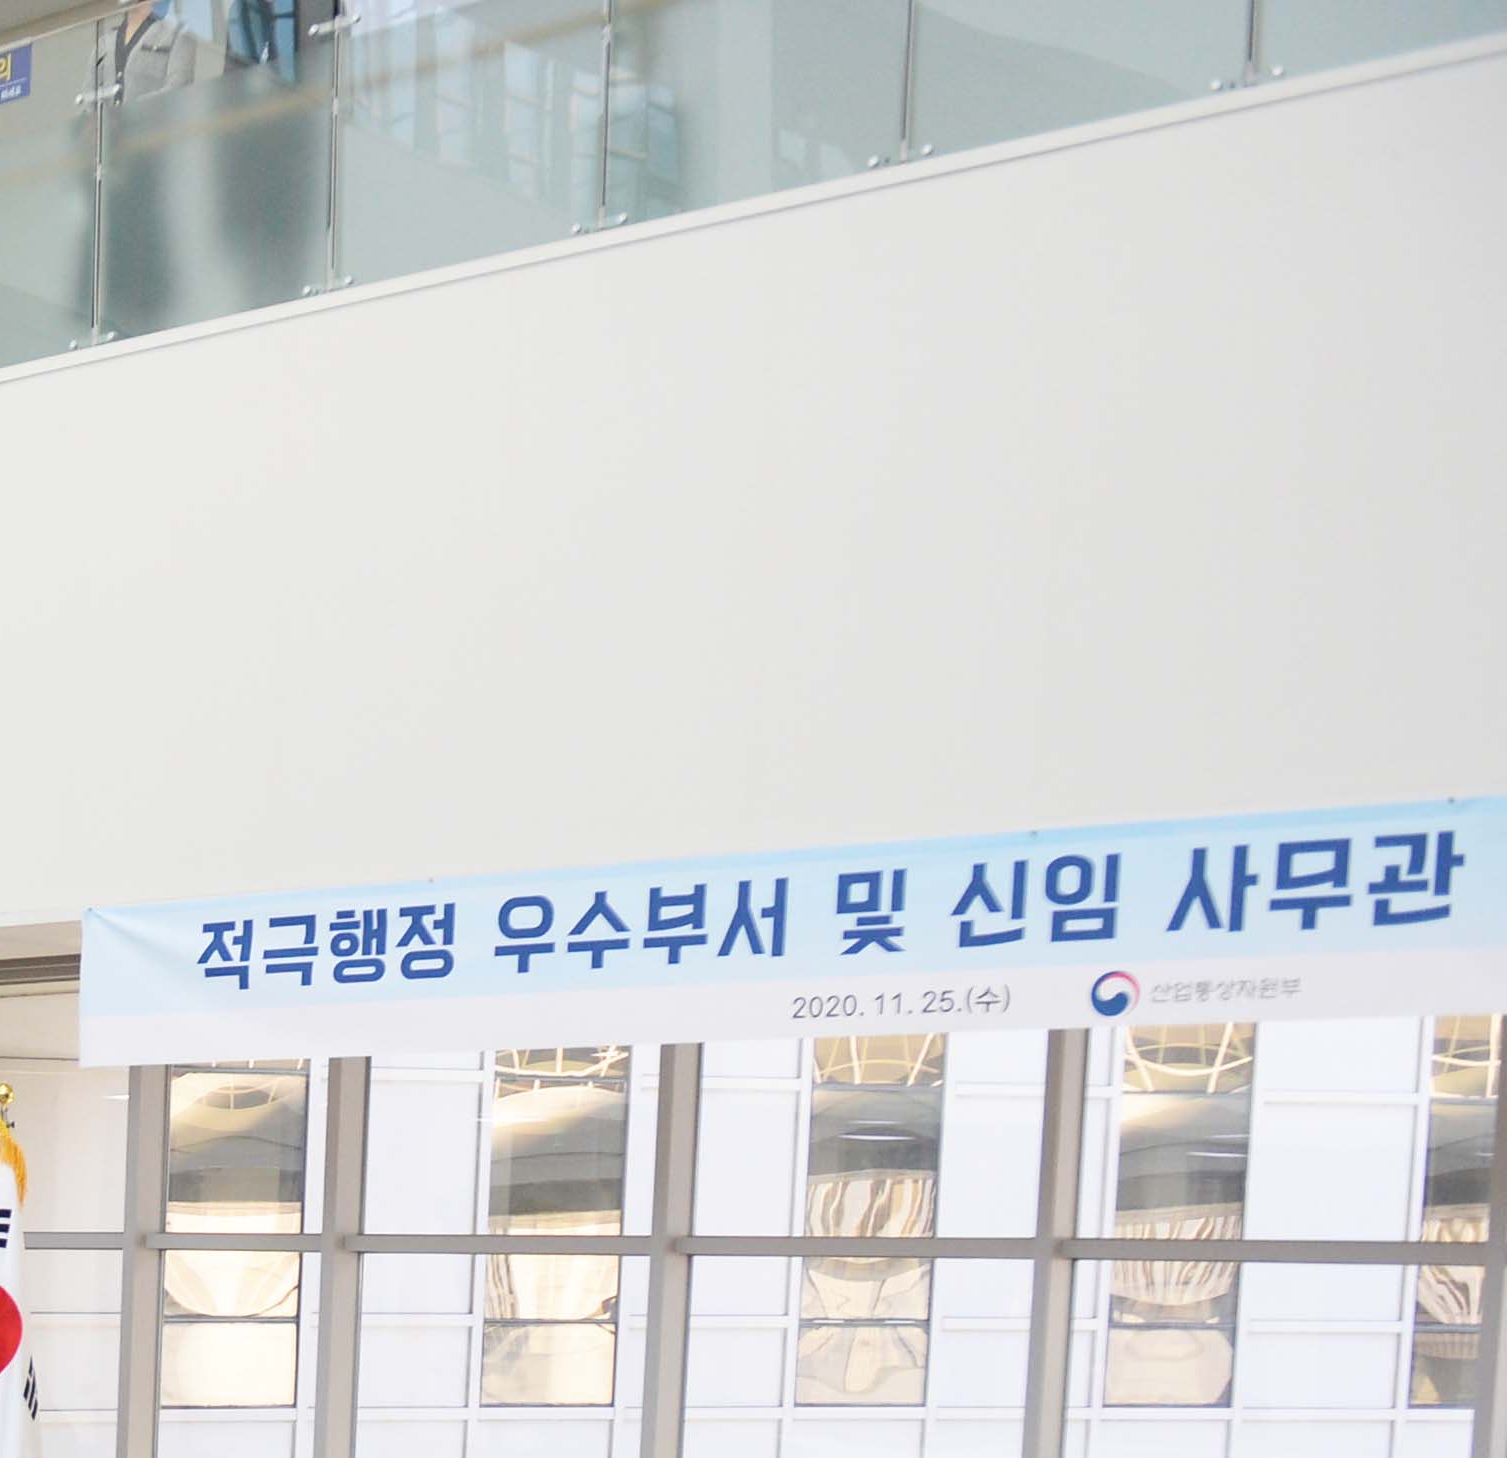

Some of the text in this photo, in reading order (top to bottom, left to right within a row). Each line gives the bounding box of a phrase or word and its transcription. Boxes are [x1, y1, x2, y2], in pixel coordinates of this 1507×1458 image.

[196, 830, 1465, 990] 적극행정 우수부서 및 신임 사무관
[1151, 976, 1303, 1004] 산업통상자원부
